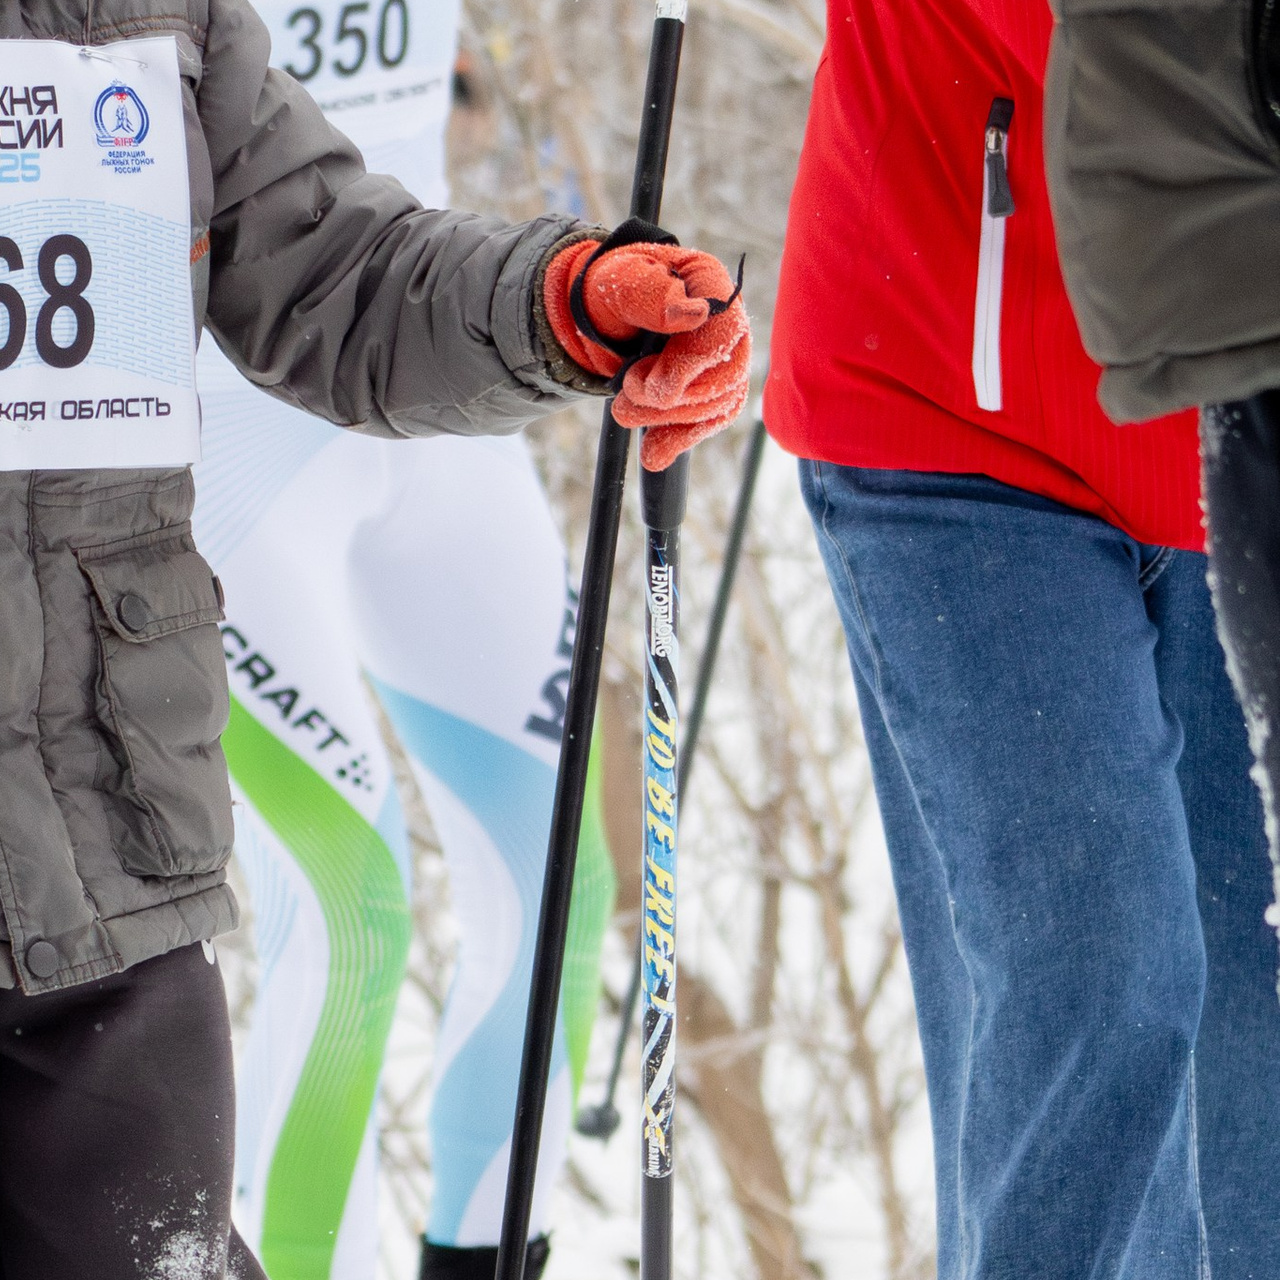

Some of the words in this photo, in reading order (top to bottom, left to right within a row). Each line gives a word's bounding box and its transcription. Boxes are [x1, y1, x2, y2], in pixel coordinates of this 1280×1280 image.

[60, 397, 171, 420] ОБЛАСТЬ
[220, 626, 351, 752] CRAFT
[646, 708, 677, 772] TO
[645, 777, 676, 851] BE
